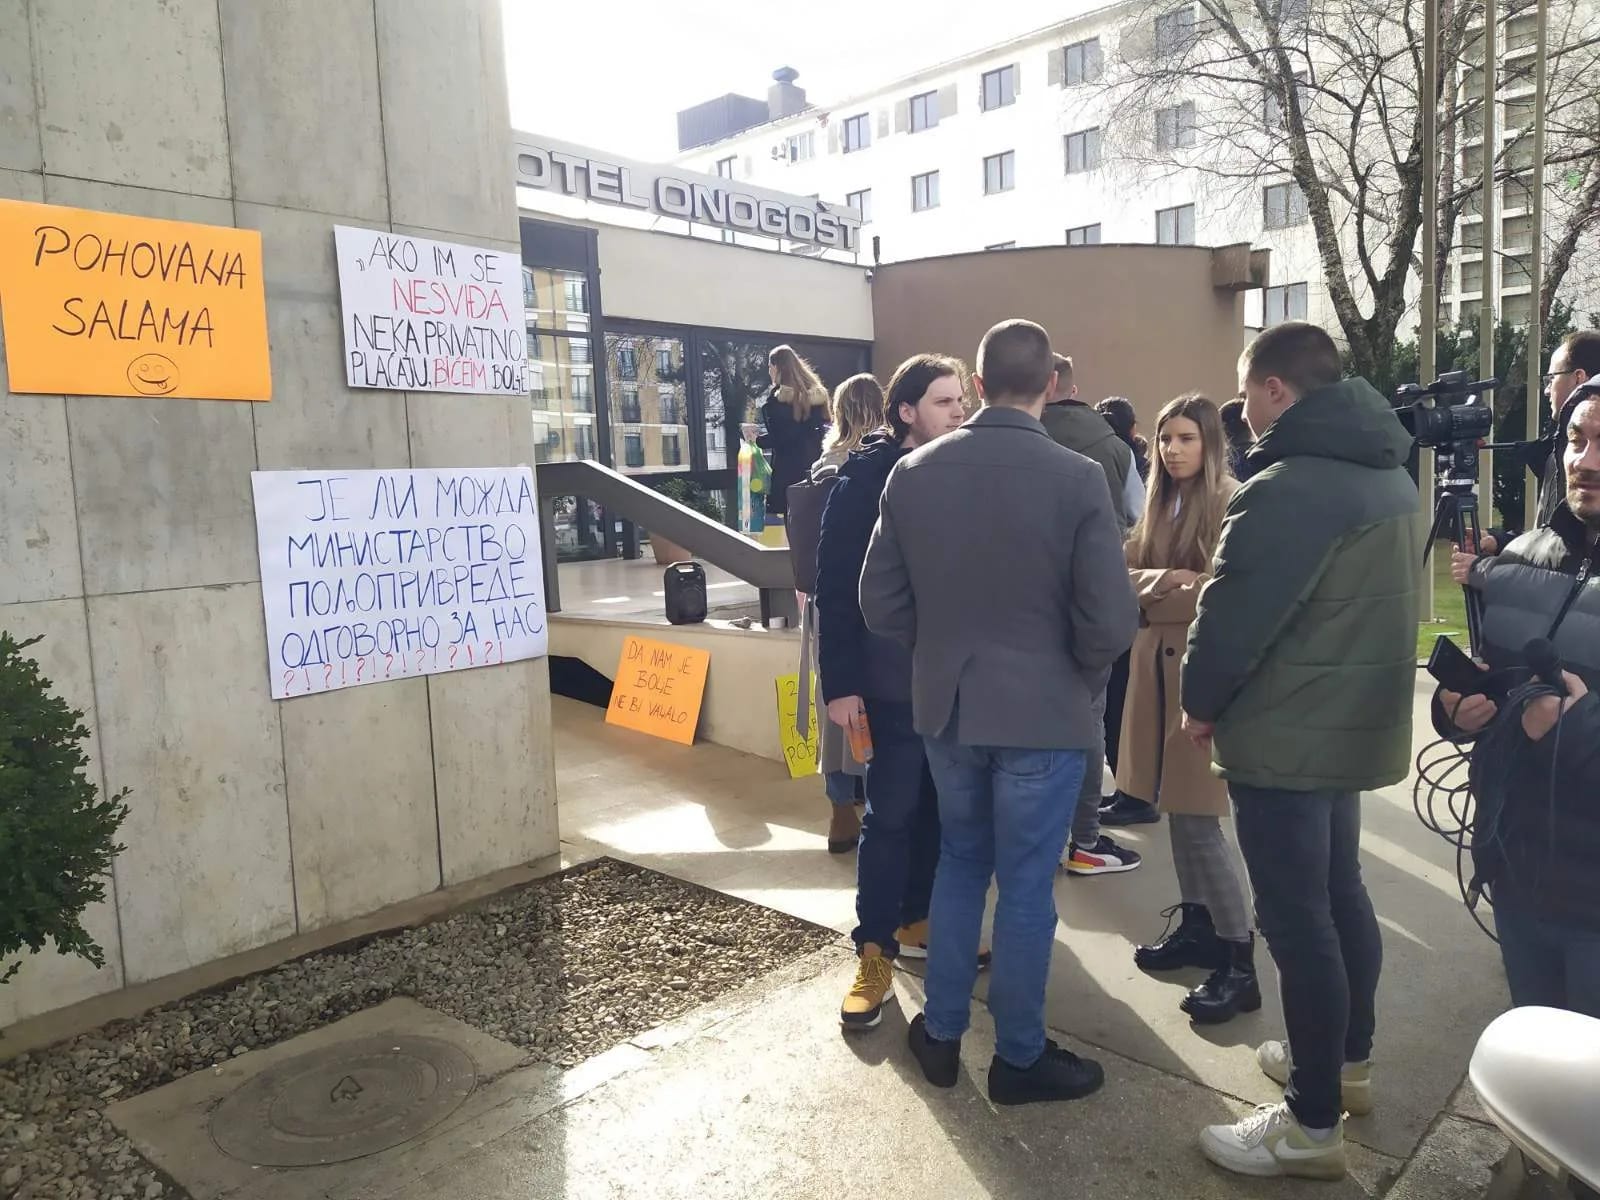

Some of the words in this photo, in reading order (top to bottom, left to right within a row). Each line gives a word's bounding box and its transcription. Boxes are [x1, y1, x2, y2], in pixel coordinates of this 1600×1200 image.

[655, 175, 862, 249] ONOGOŠT
[34, 226, 247, 290] POHOVANA
[433, 246, 456, 278] IM
[470, 253, 503, 285] SE
[52, 297, 215, 348] SALAMA
[353, 313, 421, 354] NEKA
[368, 475, 419, 520] ЛИ
[435, 475, 535, 518] МОЖДА
[287, 523, 526, 569] МИНИСТАРСТВО
[280, 615, 441, 669] ОДГОВОРНО
[448, 611, 479, 645] ЗА
[492, 602, 543, 641] НАС
[627, 640, 644, 665] DA
[650, 648, 673, 669] NAM
[678, 656, 693, 675] JE
